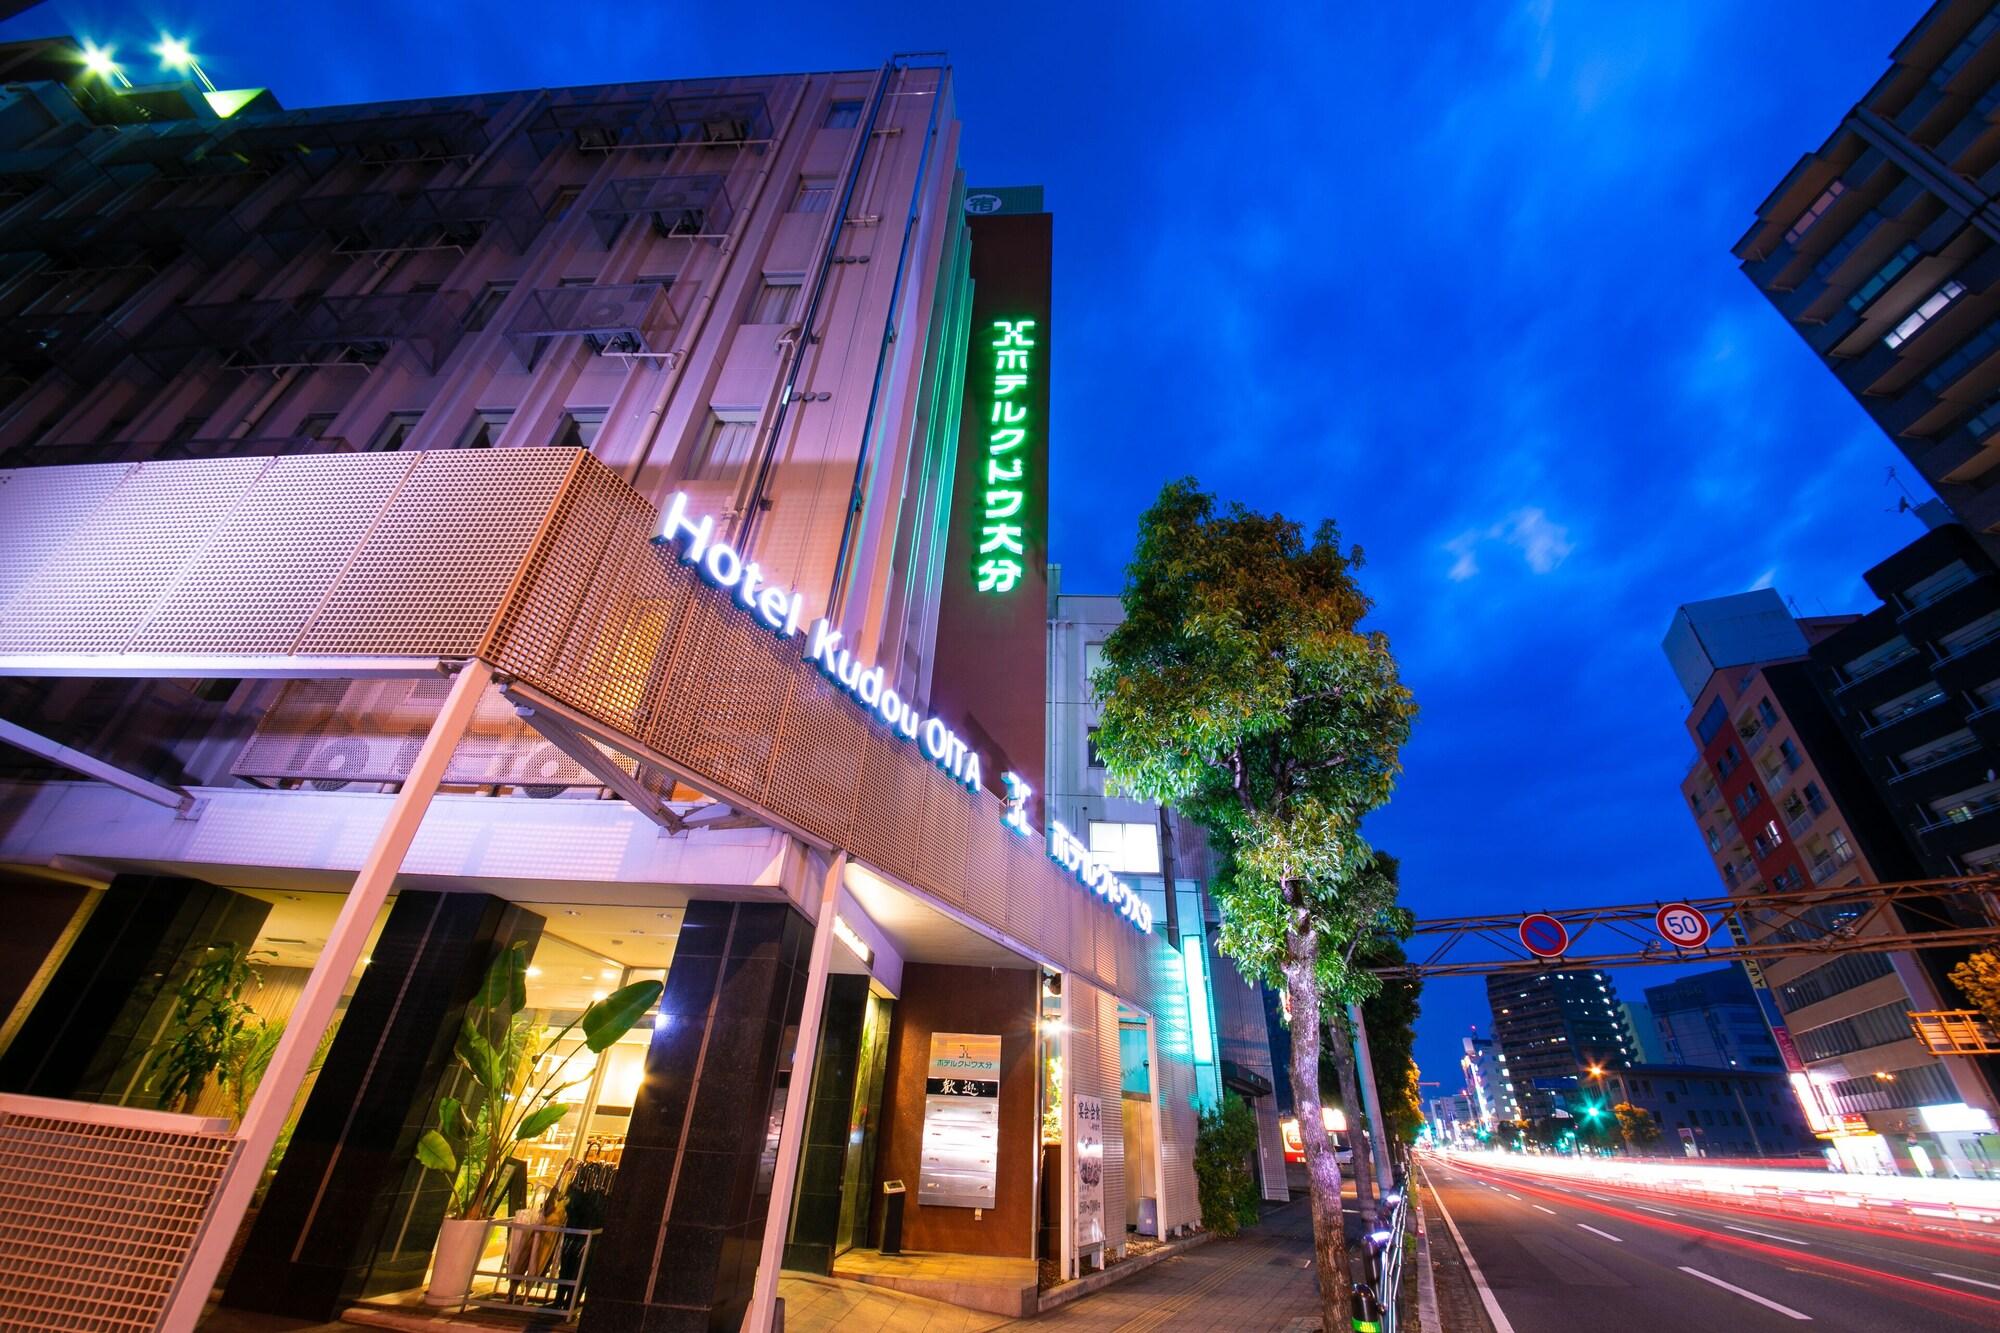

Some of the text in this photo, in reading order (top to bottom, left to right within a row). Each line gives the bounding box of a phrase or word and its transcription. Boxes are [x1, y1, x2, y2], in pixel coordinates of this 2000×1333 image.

[978, 350, 1026, 593] ホテルクドウ大分
[662, 491, 982, 793] Hotel Kudou OITA
[1053, 820, 1153, 934] ホテルクドウ大分
[1667, 916, 1697, 935] 50
[936, 1059, 993, 1069] ホテルクドウ大分
